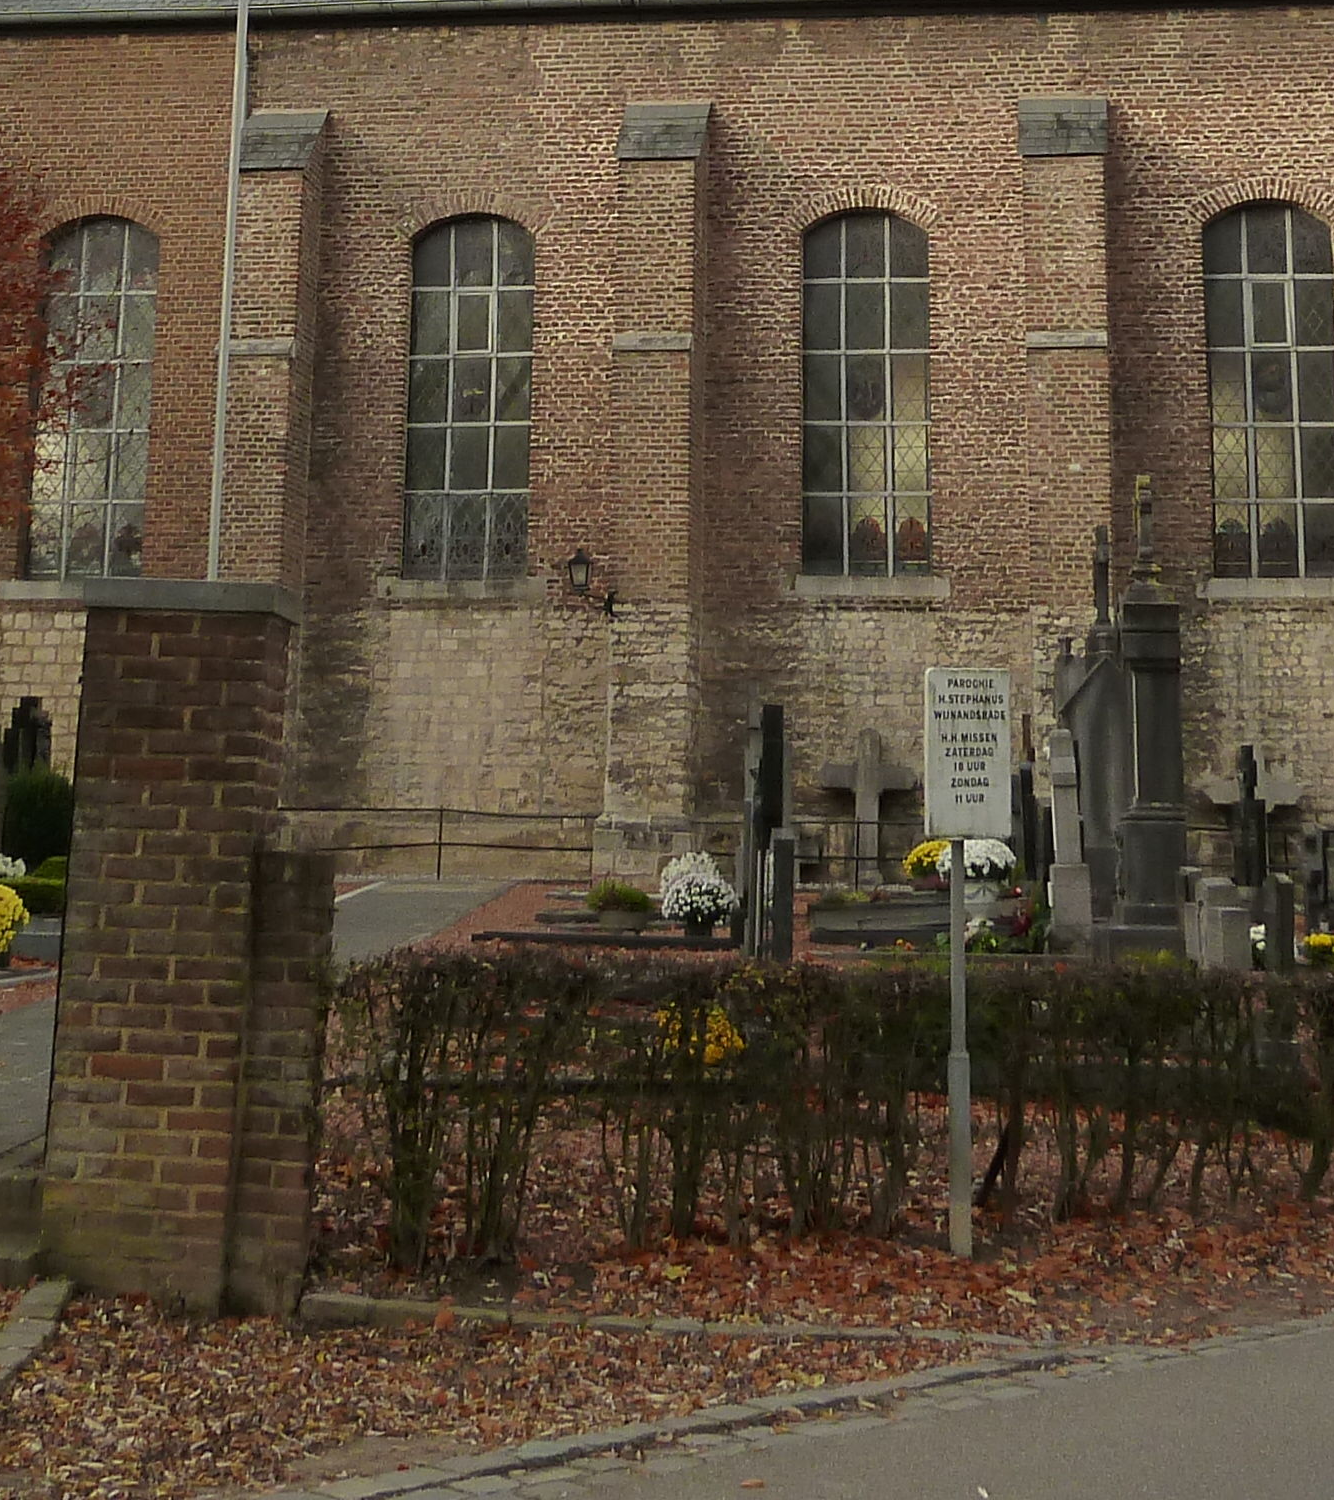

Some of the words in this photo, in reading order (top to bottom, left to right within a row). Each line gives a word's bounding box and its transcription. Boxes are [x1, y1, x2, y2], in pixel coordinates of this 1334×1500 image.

[945, 747, 994, 757] ZATERDAG
[967, 762, 986, 771] UUR
[951, 777, 989, 788] ZONDAG
[966, 793, 985, 803] UUR
